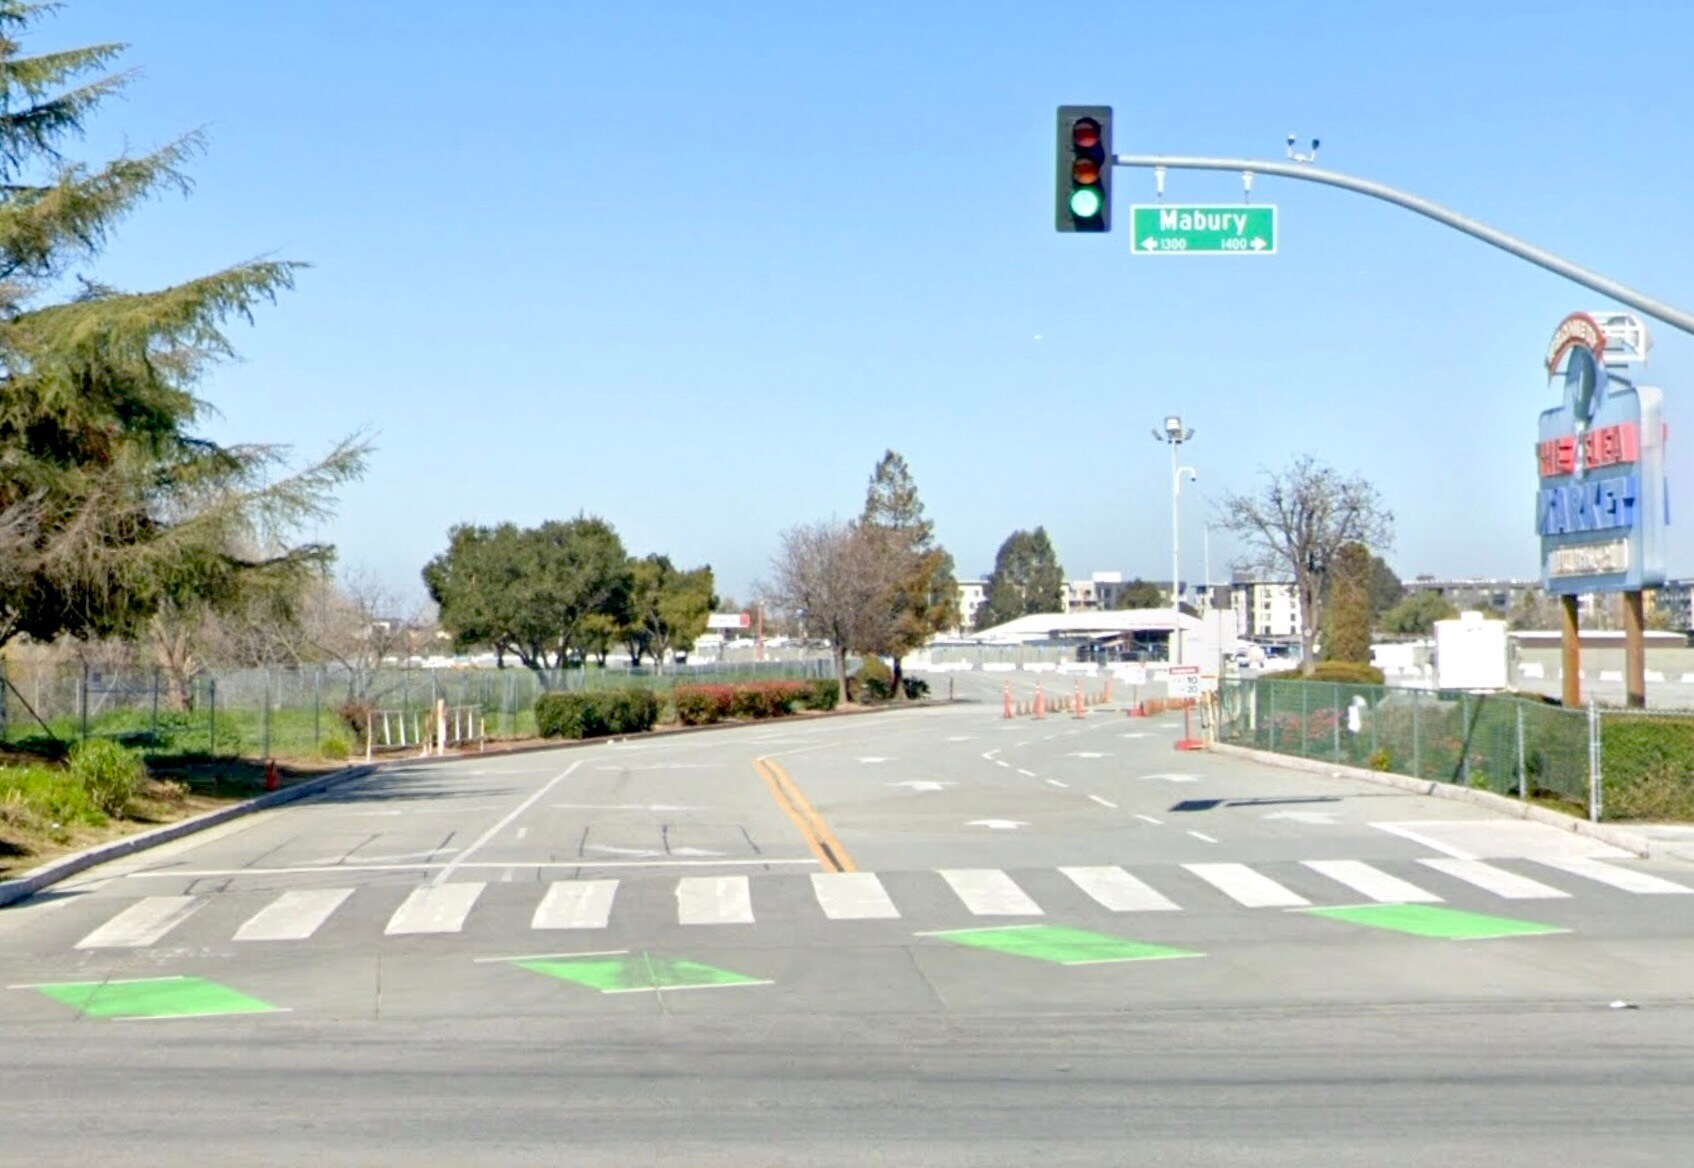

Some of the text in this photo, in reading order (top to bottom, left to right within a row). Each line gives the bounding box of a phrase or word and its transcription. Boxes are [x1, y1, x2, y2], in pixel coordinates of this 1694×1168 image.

[1159, 208, 1247, 235] Mabury
[1160, 238, 1187, 250] 1300
[1221, 238, 1247, 250] 1400
